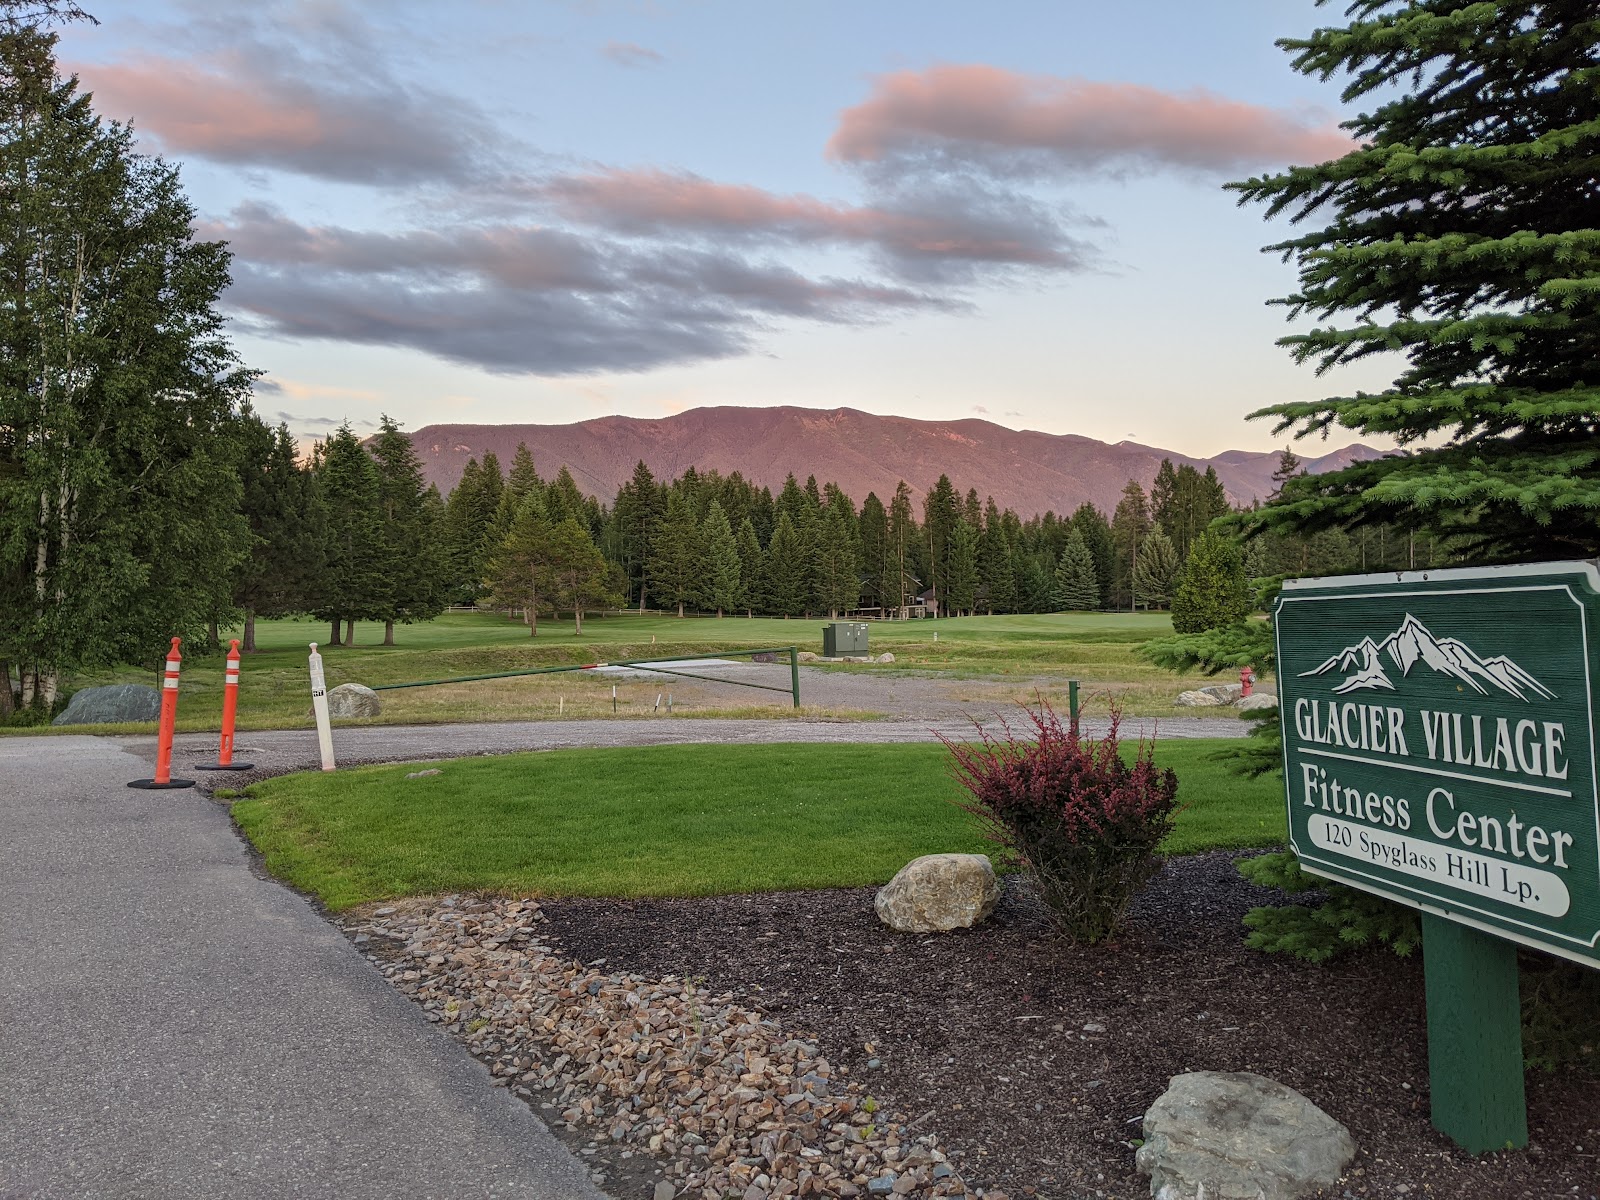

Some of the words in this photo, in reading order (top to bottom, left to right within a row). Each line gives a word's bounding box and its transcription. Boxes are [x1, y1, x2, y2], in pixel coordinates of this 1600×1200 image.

[1295, 698, 1410, 756] GLACIER
[1420, 710, 1569, 780] VILLAGE
[1300, 762, 1411, 830] Fitness
[1426, 787, 1573, 869] Center
[1325, 822, 1352, 847] 120
[1359, 831, 1436, 872] Spyglass
[1446, 853, 1490, 888] Hill
[1502, 868, 1540, 903] Lp.
